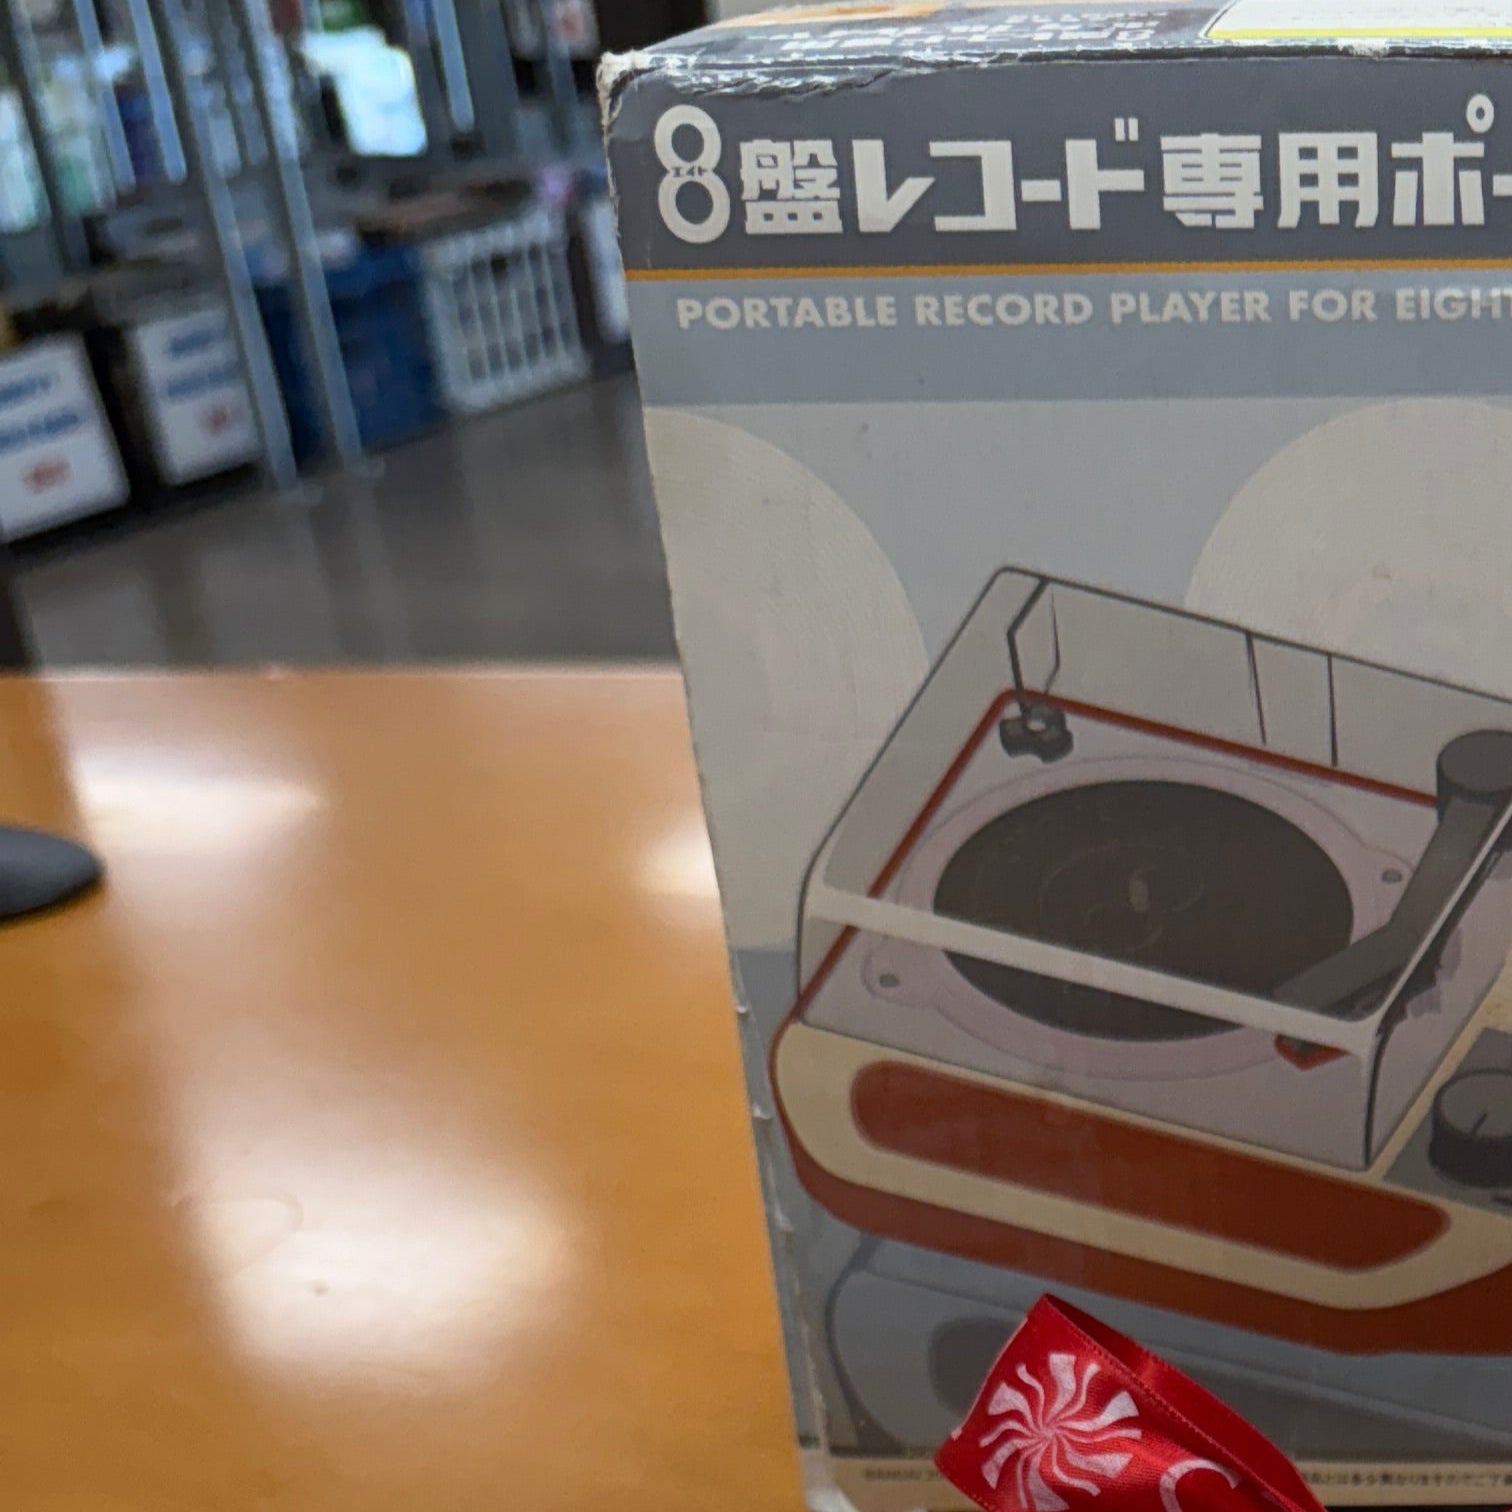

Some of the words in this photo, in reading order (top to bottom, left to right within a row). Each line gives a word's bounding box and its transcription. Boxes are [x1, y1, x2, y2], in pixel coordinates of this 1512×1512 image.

[676, 294, 898, 331] PORTABLE
[914, 292, 1094, 327] RECORD
[1110, 291, 1271, 324] PLAYER
[1288, 289, 1378, 322] FOR
